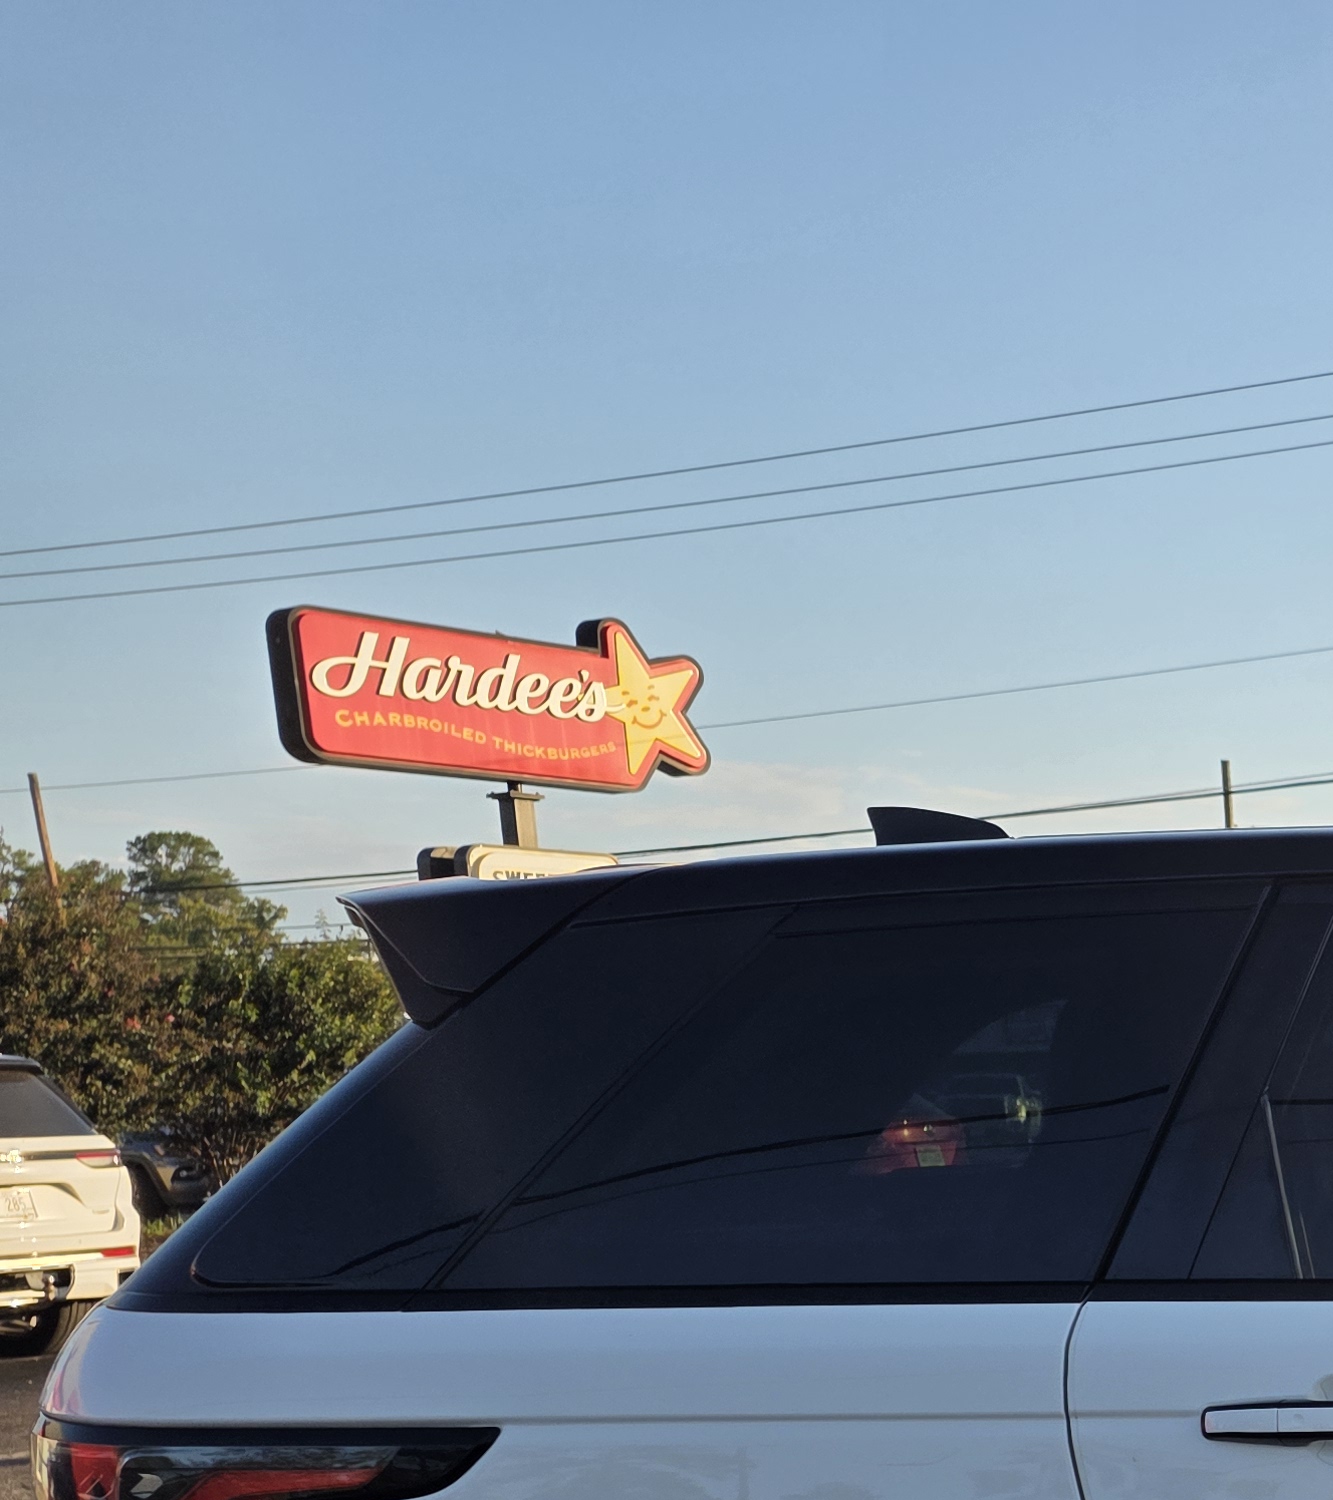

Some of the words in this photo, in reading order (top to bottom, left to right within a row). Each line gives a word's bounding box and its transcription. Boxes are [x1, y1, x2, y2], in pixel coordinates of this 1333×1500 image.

[312, 631, 608, 723] Hardee's
[334, 708, 487, 745] CHARBROILED
[491, 734, 617, 761] THICKBURGERS
